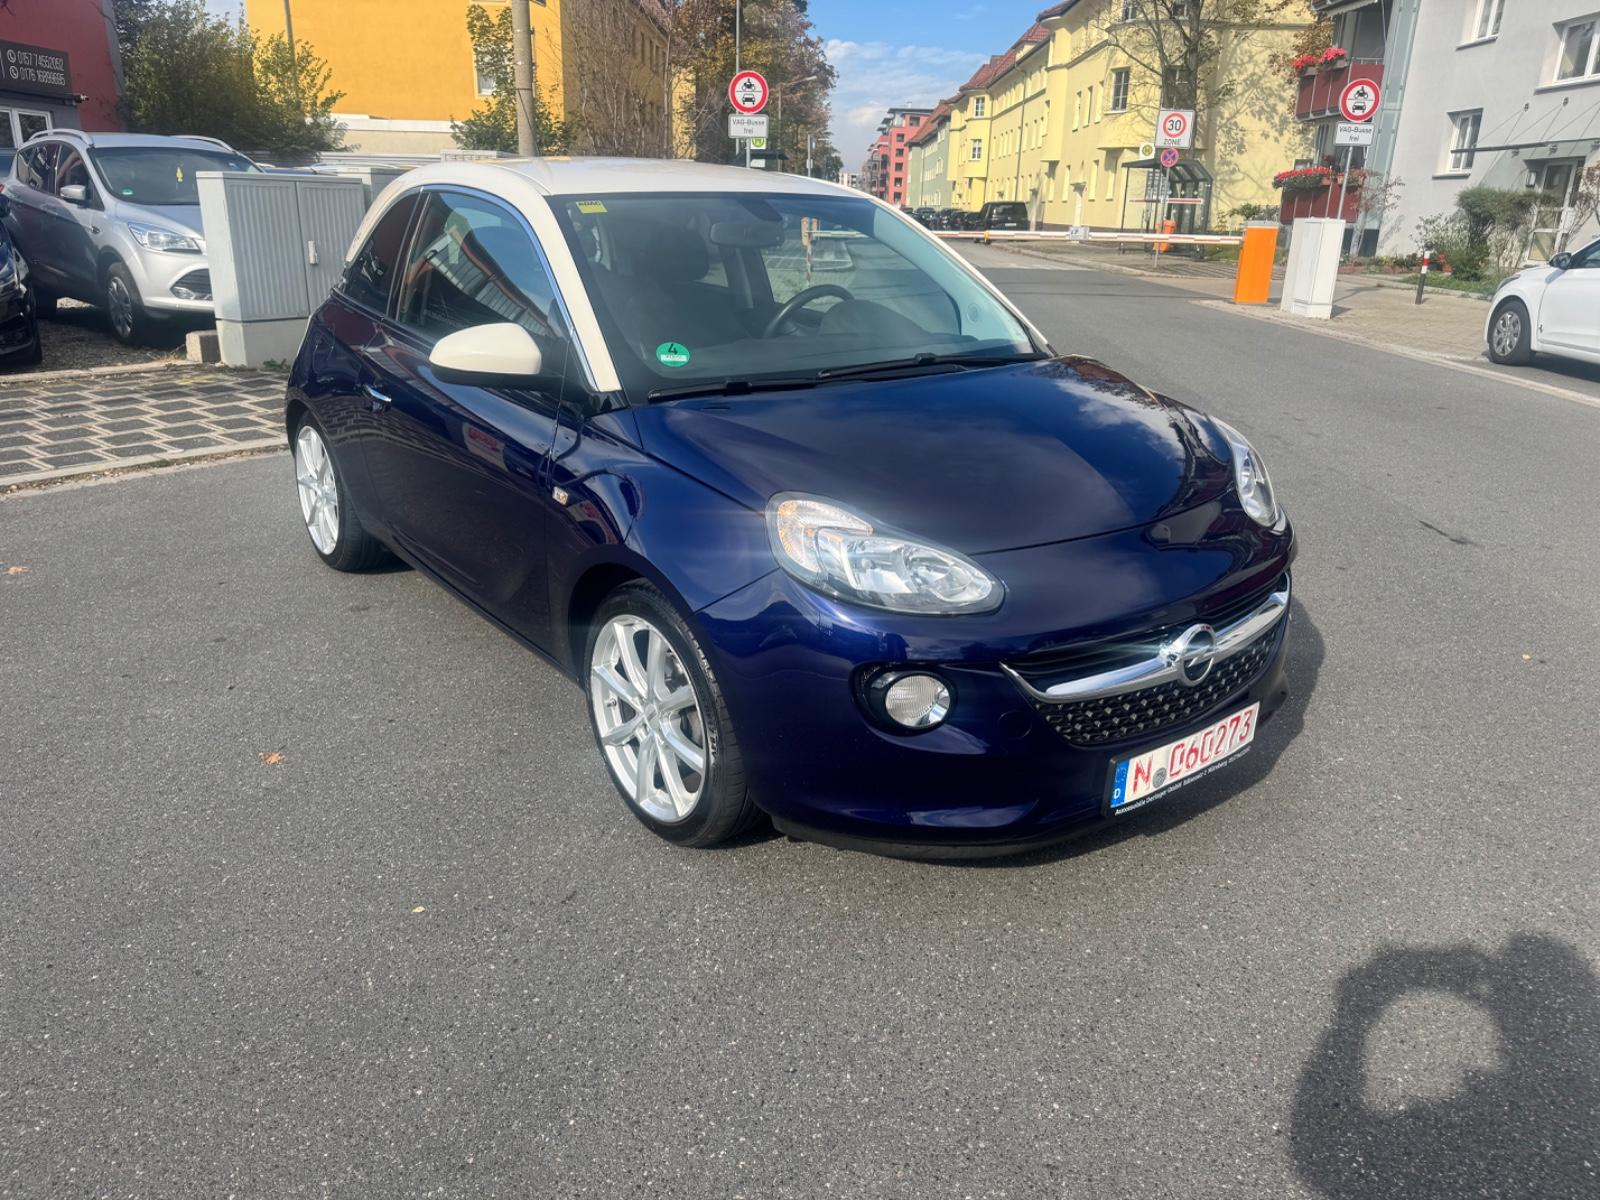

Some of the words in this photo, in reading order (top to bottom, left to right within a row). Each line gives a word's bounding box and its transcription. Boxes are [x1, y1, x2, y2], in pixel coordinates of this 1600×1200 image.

[1167, 119, 1182, 131] 30
[668, 343, 678, 355] 4
[1132, 756, 1154, 796] N
[1113, 787, 1121, 799] D
